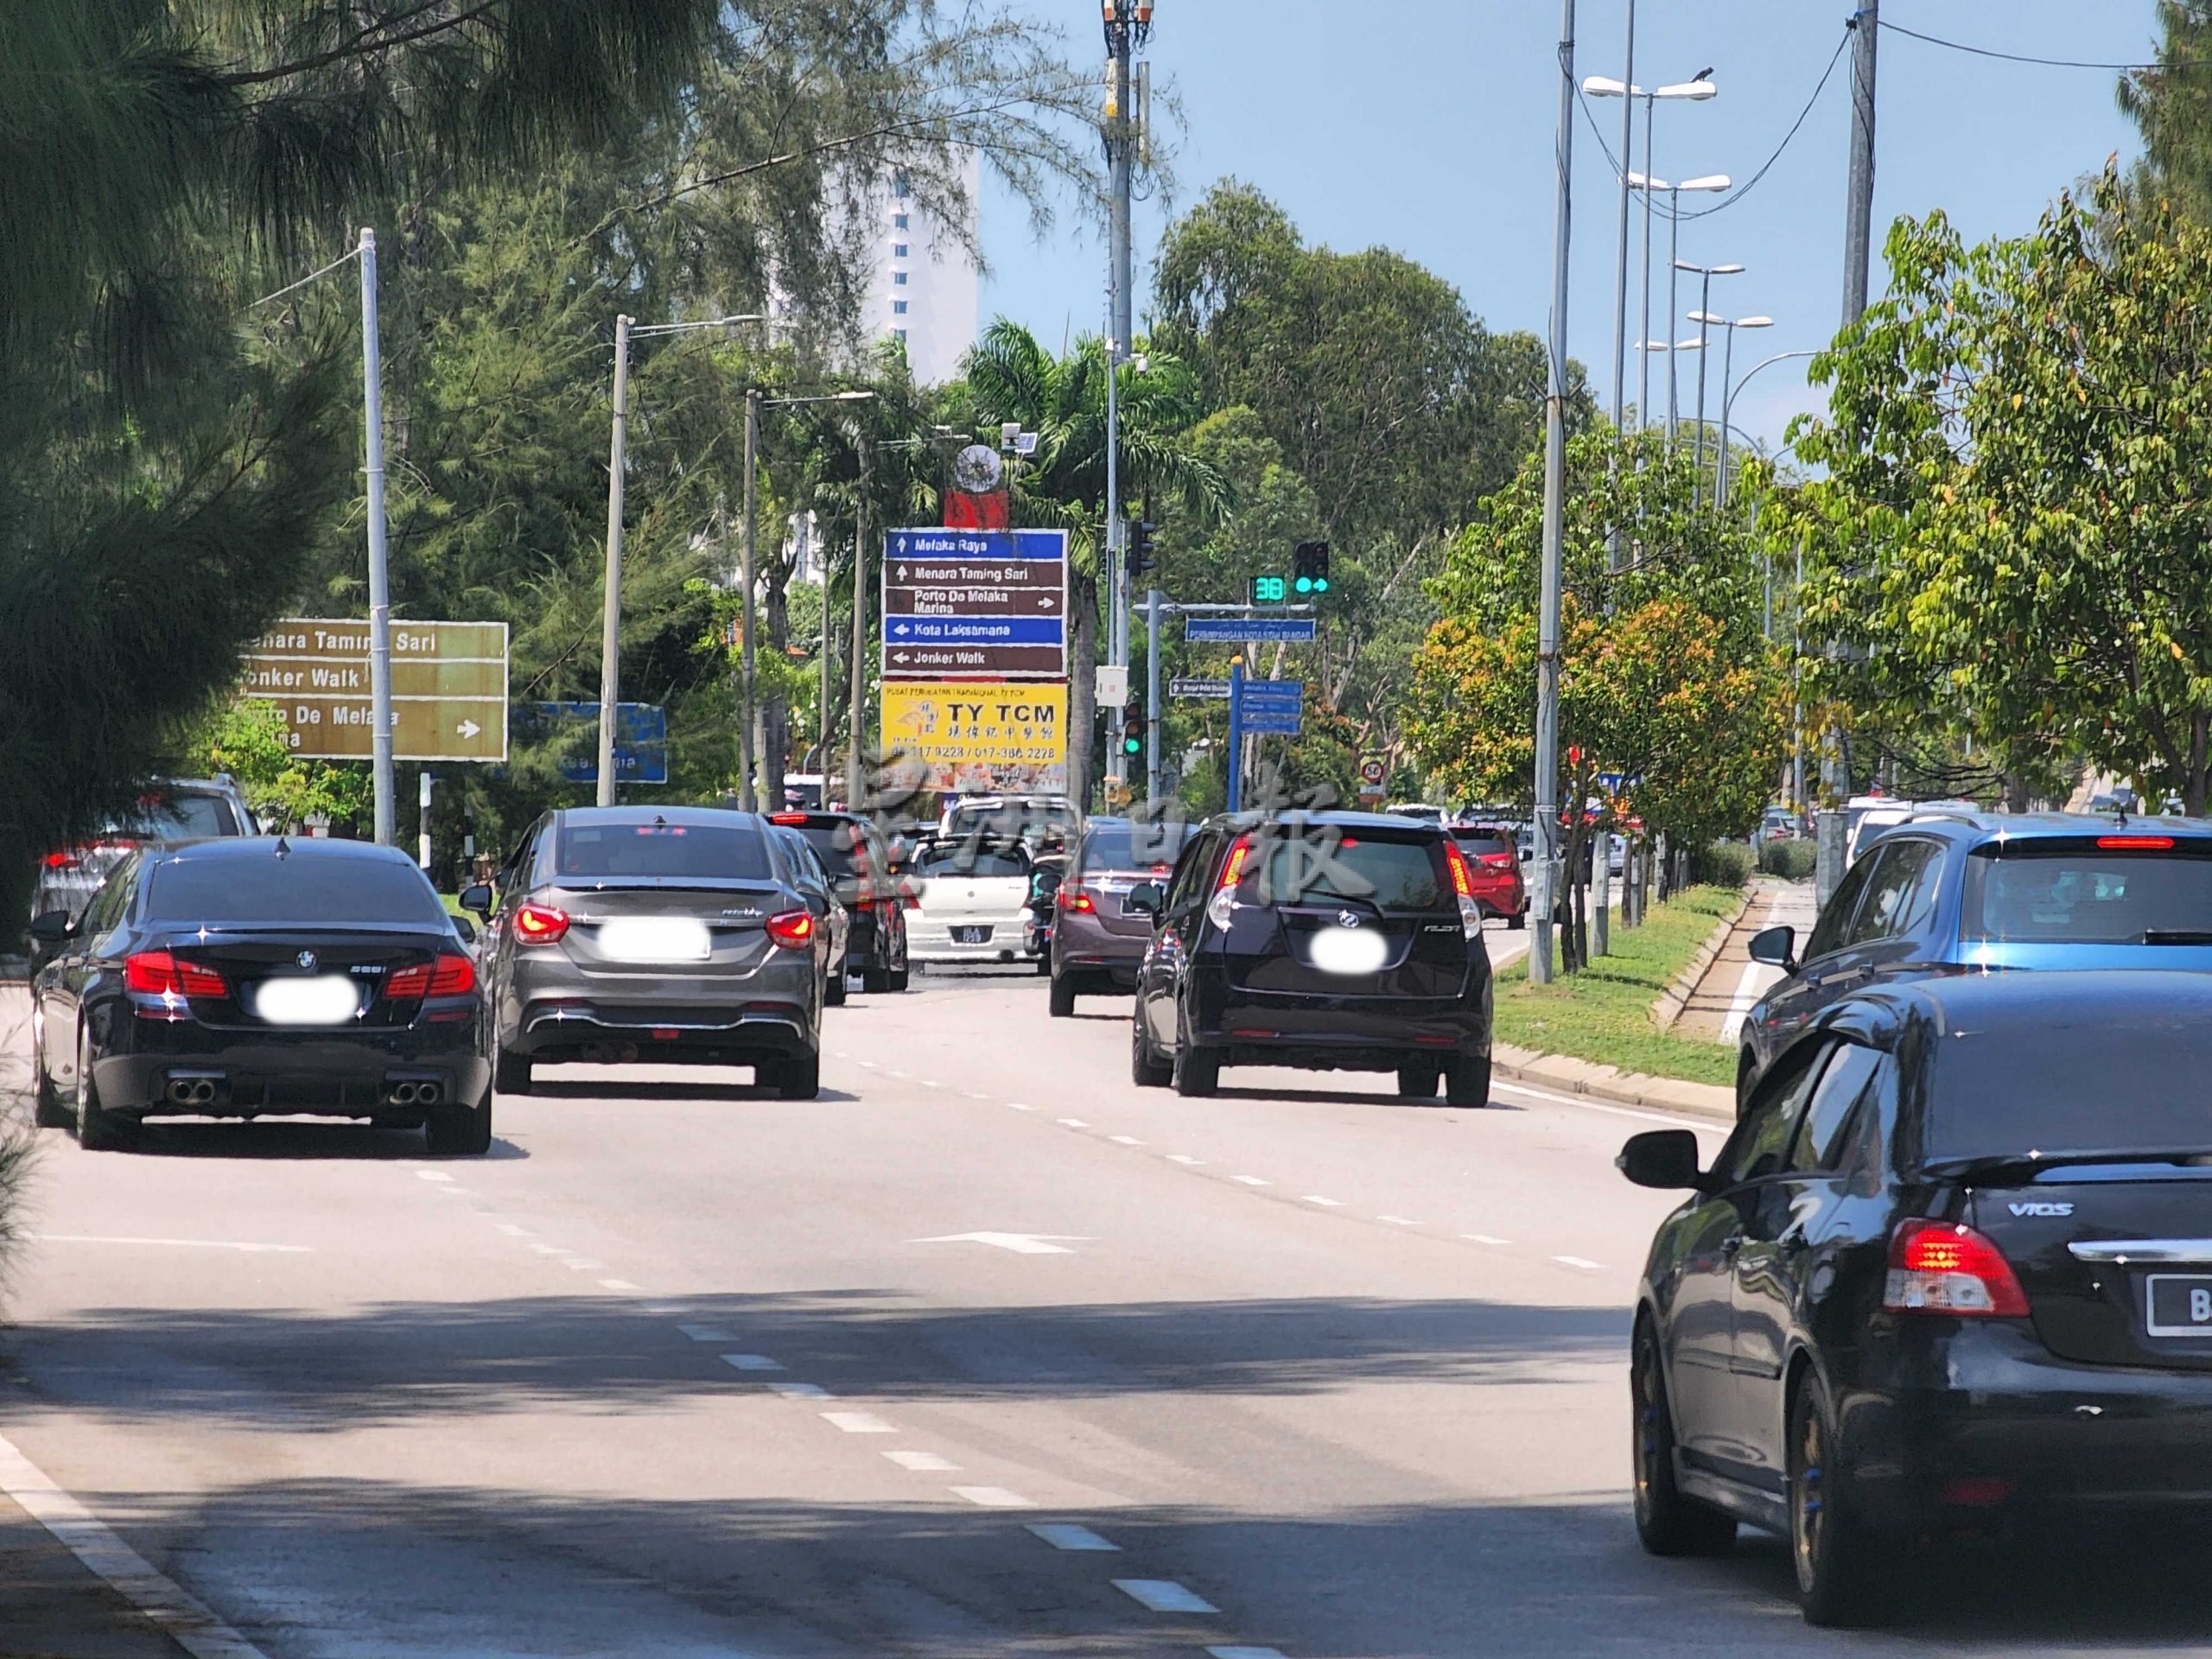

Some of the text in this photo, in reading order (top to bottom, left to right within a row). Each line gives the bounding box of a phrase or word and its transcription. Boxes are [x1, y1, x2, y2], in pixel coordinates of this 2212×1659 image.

[914, 538, 988, 554] Melaka Raya
[914, 567, 1028, 582] Menara Taming Sari
[914, 590, 1008, 602] Porto De Melaka
[914, 601, 954, 614] Marina
[914, 624, 1011, 638] Kota Laksamana
[396, 633, 435, 652] Sari
[914, 651, 986, 664] Jonker Walk
[247, 667, 359, 688] onker Walk
[296, 705, 321, 724] De
[333, 706, 399, 726] Melaa
[947, 703, 983, 722] TY
[996, 704, 1054, 723] TCM
[2008, 1203, 2074, 1217] VIOS
[2190, 1288, 2212, 1322] B
